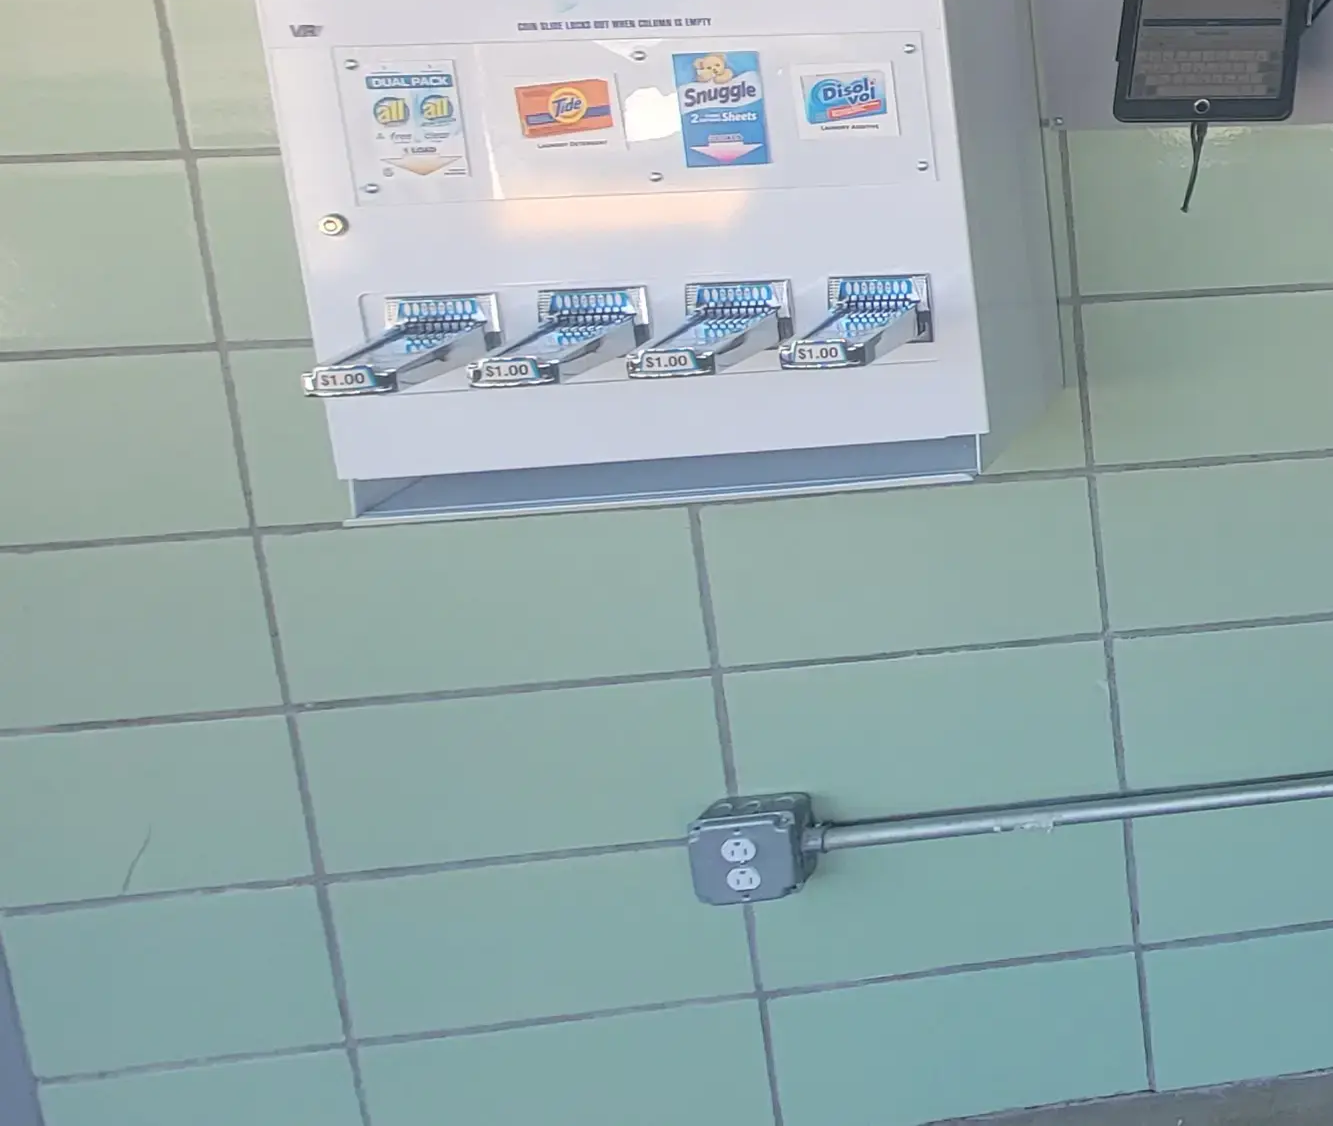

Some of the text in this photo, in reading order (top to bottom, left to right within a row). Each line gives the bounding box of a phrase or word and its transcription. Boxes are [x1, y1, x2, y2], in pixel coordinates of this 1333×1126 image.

[612, 19, 636, 29] WHEN
[638, 18, 672, 28] COLUMN
[675, 18, 682, 27] IS
[686, 18, 712, 26] EMPTY
[372, 76, 448, 87] DUAL PACK
[823, 77, 868, 101] Disol
[684, 82, 756, 107] Snuggle
[376, 98, 405, 124] all
[423, 96, 449, 119] all
[552, 98, 582, 117] Tide
[691, 114, 699, 123] 2
[722, 112, 757, 122] Sheets
[644, 353, 689, 369] $1.00
[797, 345, 839, 361] $1.00
[483, 362, 529, 378] $1.00
[319, 372, 366, 388] $1.00
